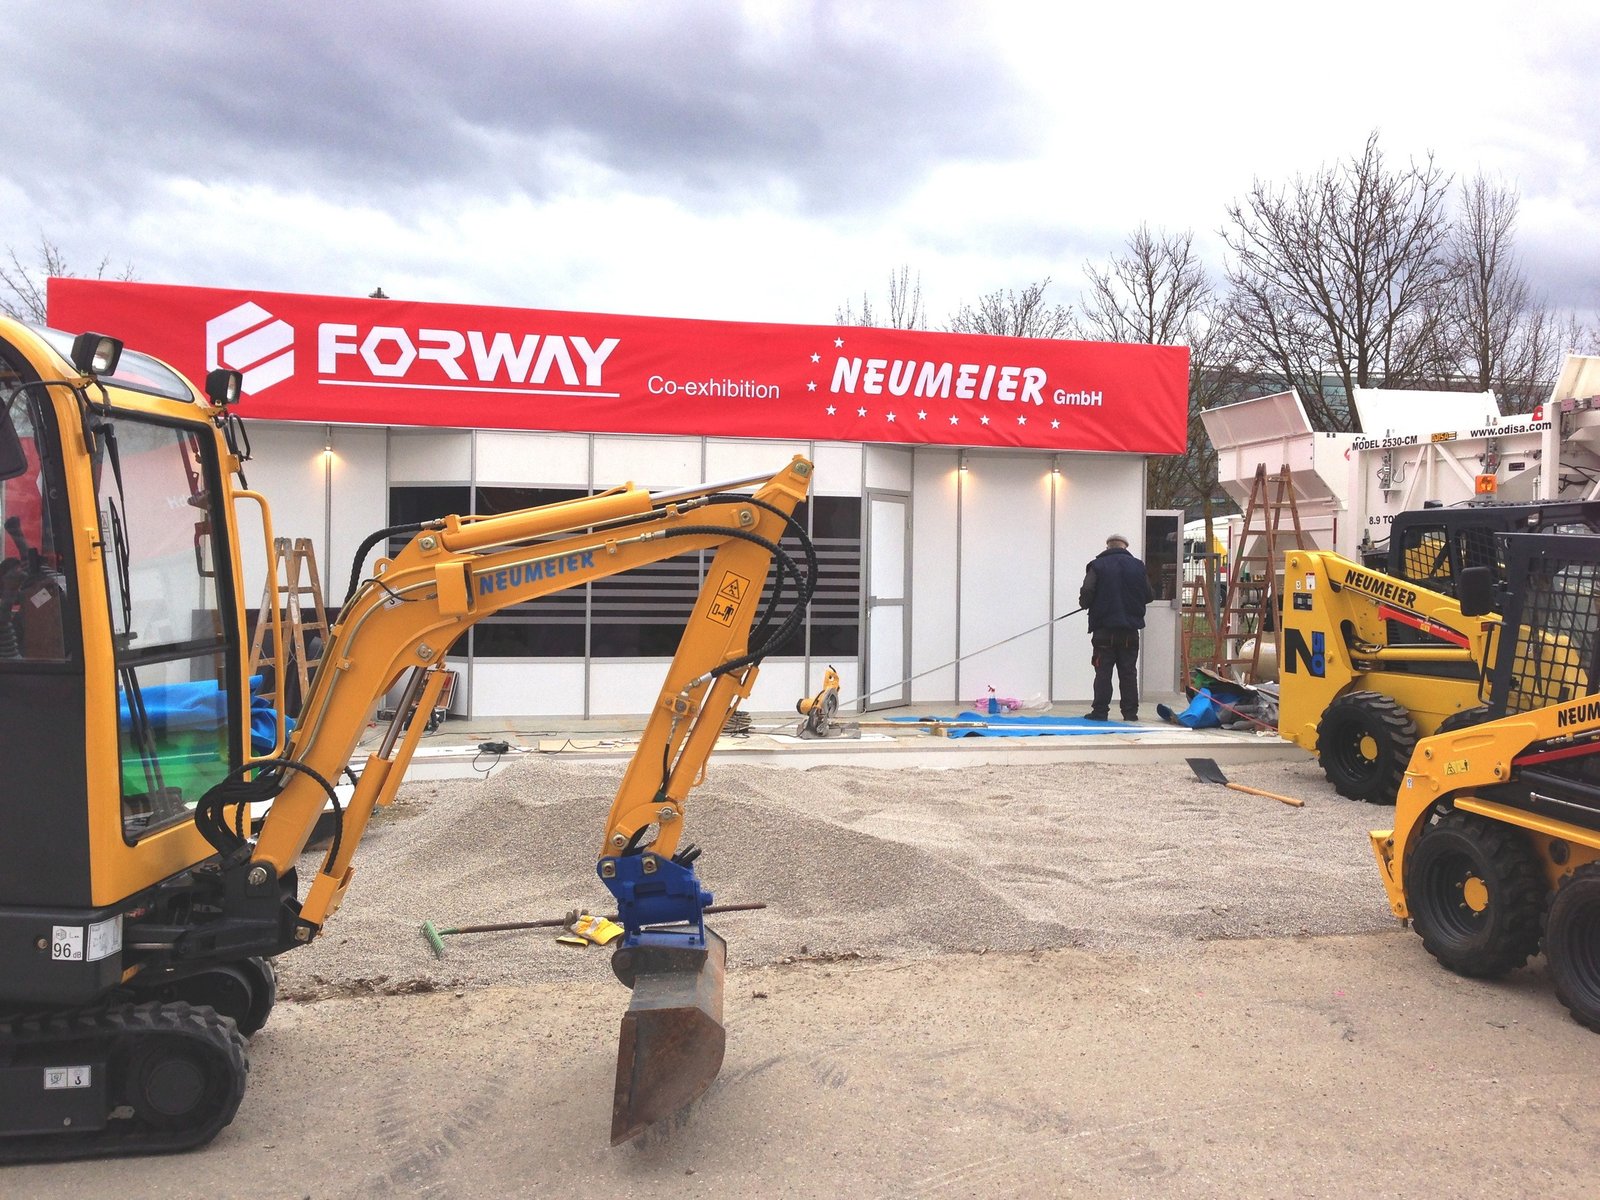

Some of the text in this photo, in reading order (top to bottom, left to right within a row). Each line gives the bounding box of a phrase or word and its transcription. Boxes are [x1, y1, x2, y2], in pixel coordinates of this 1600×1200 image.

[318, 323, 620, 387] FORWAY
[648, 375, 780, 399] Co-exhibition
[830, 356, 1103, 406] NEUMEIER GmbH
[1470, 421, 1552, 437] www.odisa.com
[1352, 435, 1418, 451] MODEL 2530-CM
[1369, 516, 1381, 525] 8.9
[479, 552, 595, 595] NEUMEIER
[1344, 569, 1417, 609] NEUMEIER
[53, 942, 71, 958] 96
